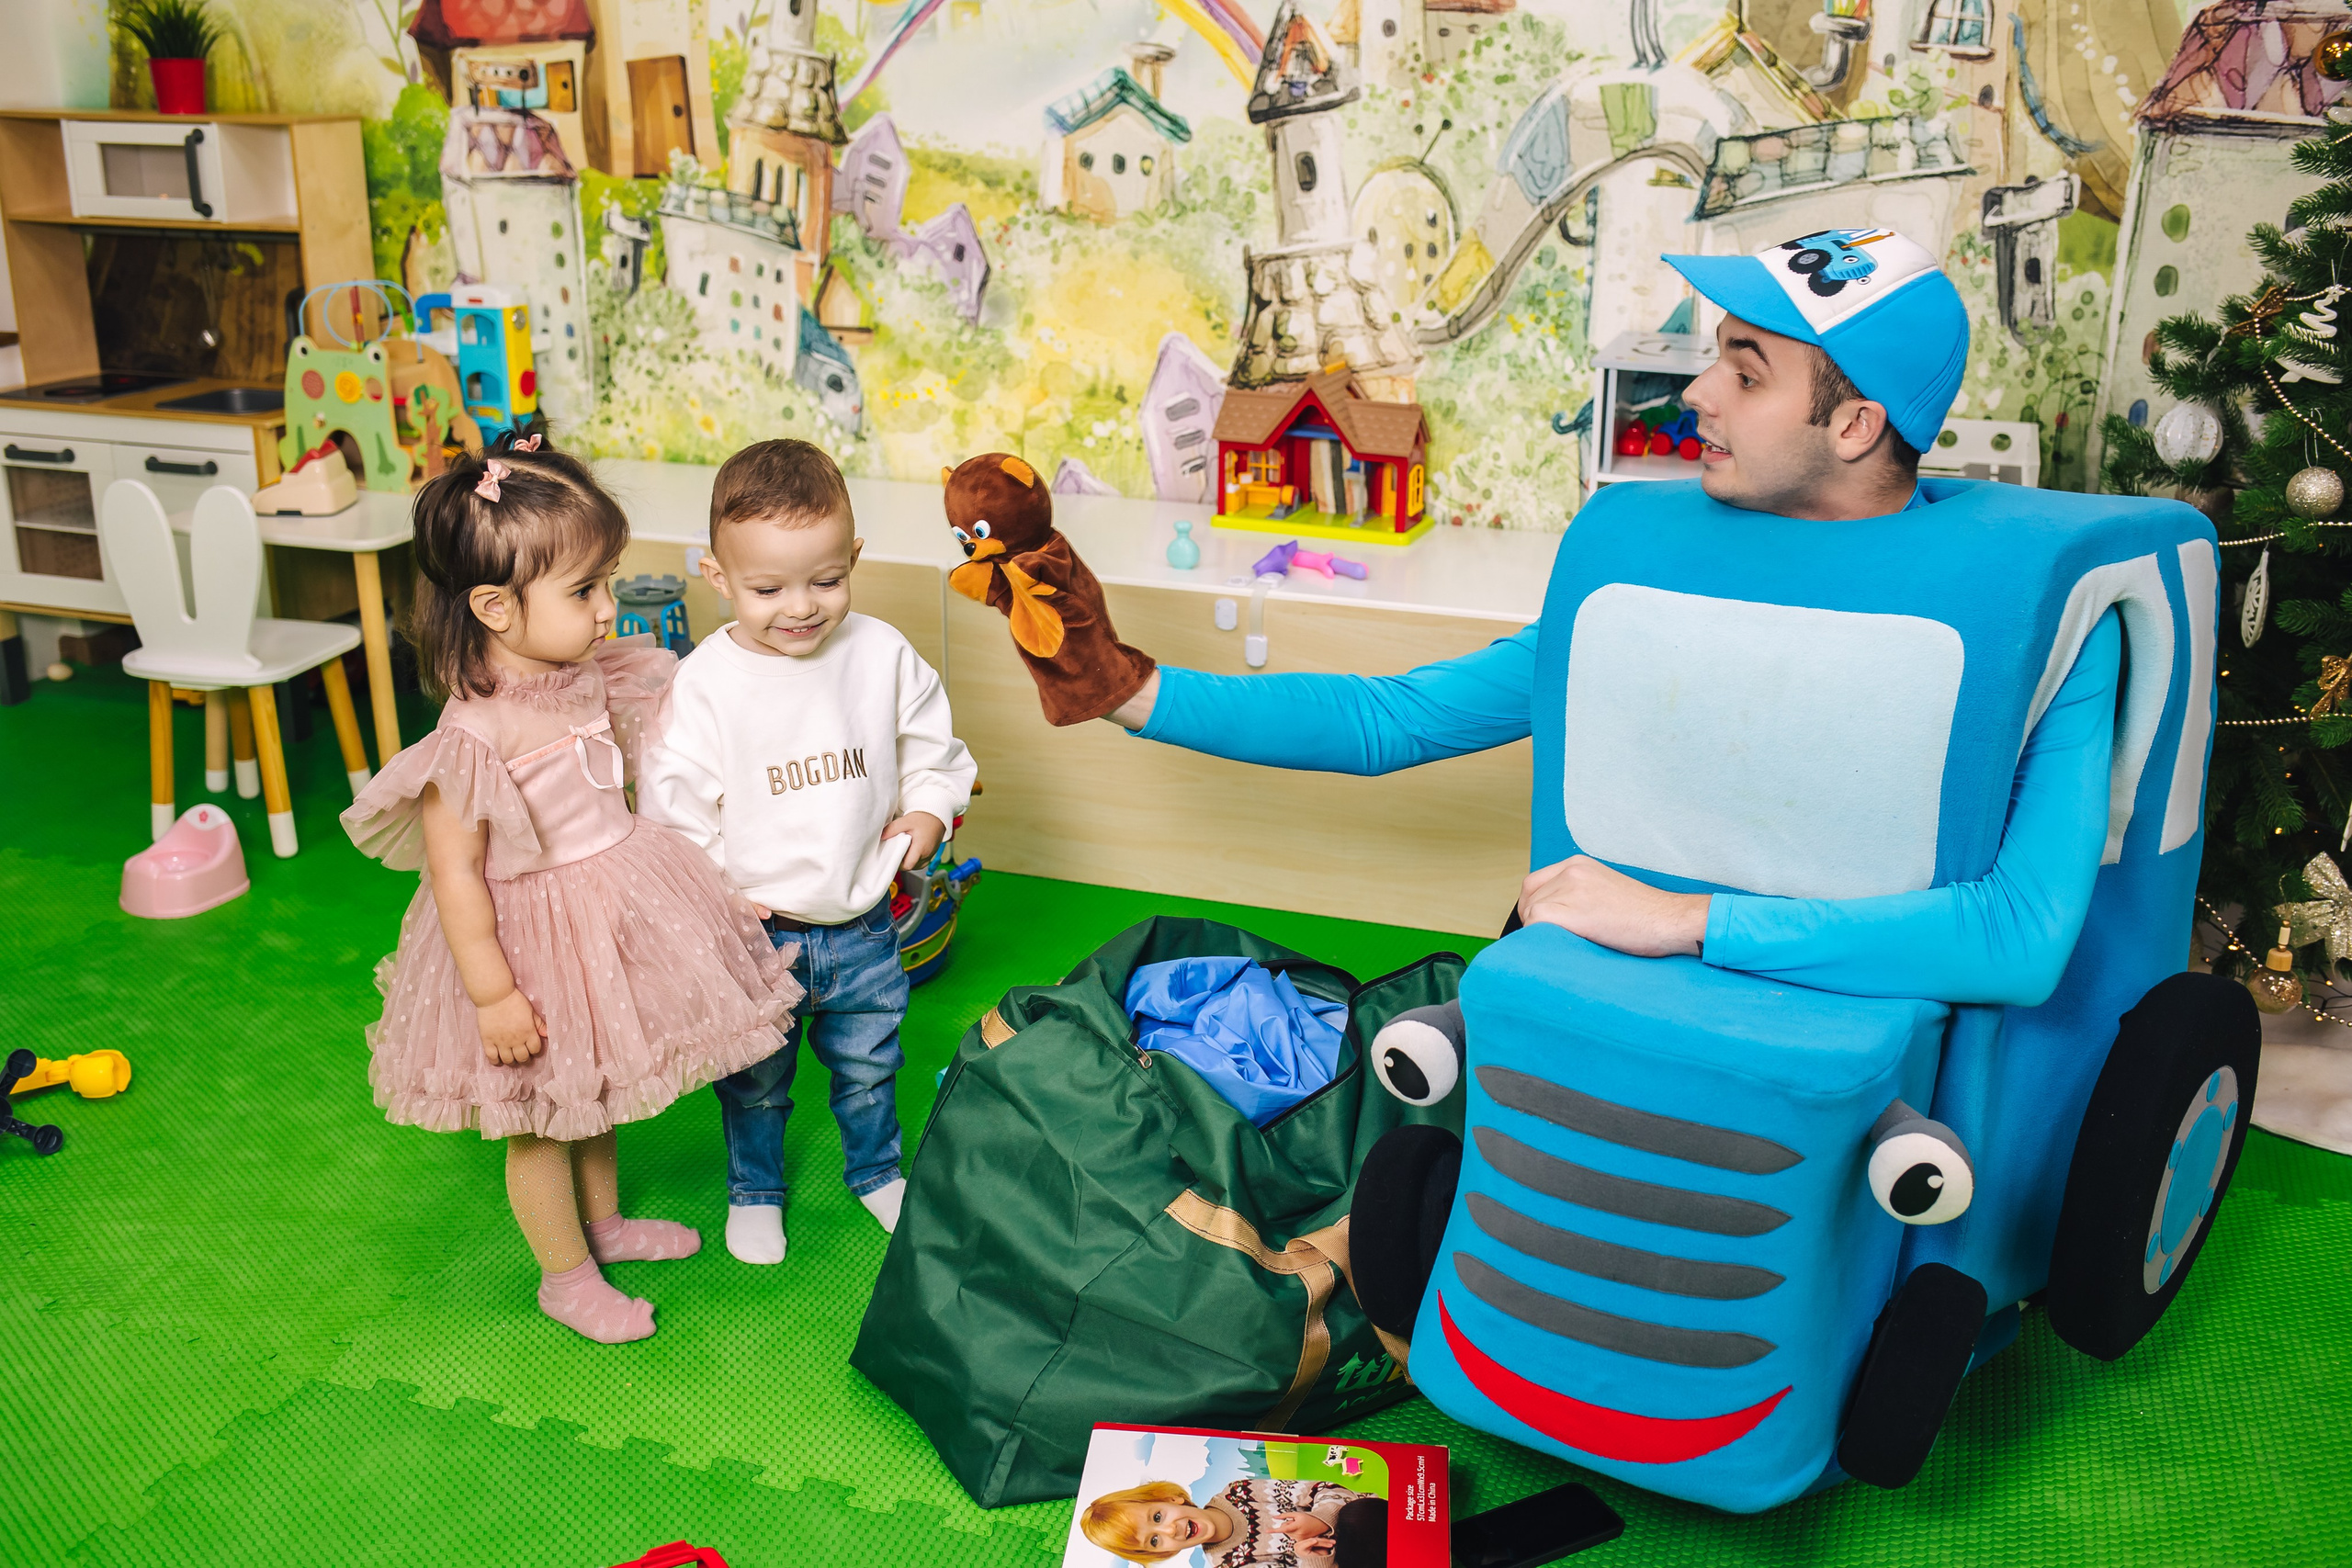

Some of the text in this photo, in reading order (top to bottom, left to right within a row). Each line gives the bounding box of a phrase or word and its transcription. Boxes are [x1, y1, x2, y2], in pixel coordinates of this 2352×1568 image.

[766, 748, 867, 795] BOGDAN
[1406, 1484, 1416, 1520] Package size
[1428, 1483, 1436, 1499] China
[1428, 1506, 1436, 1522] Made
